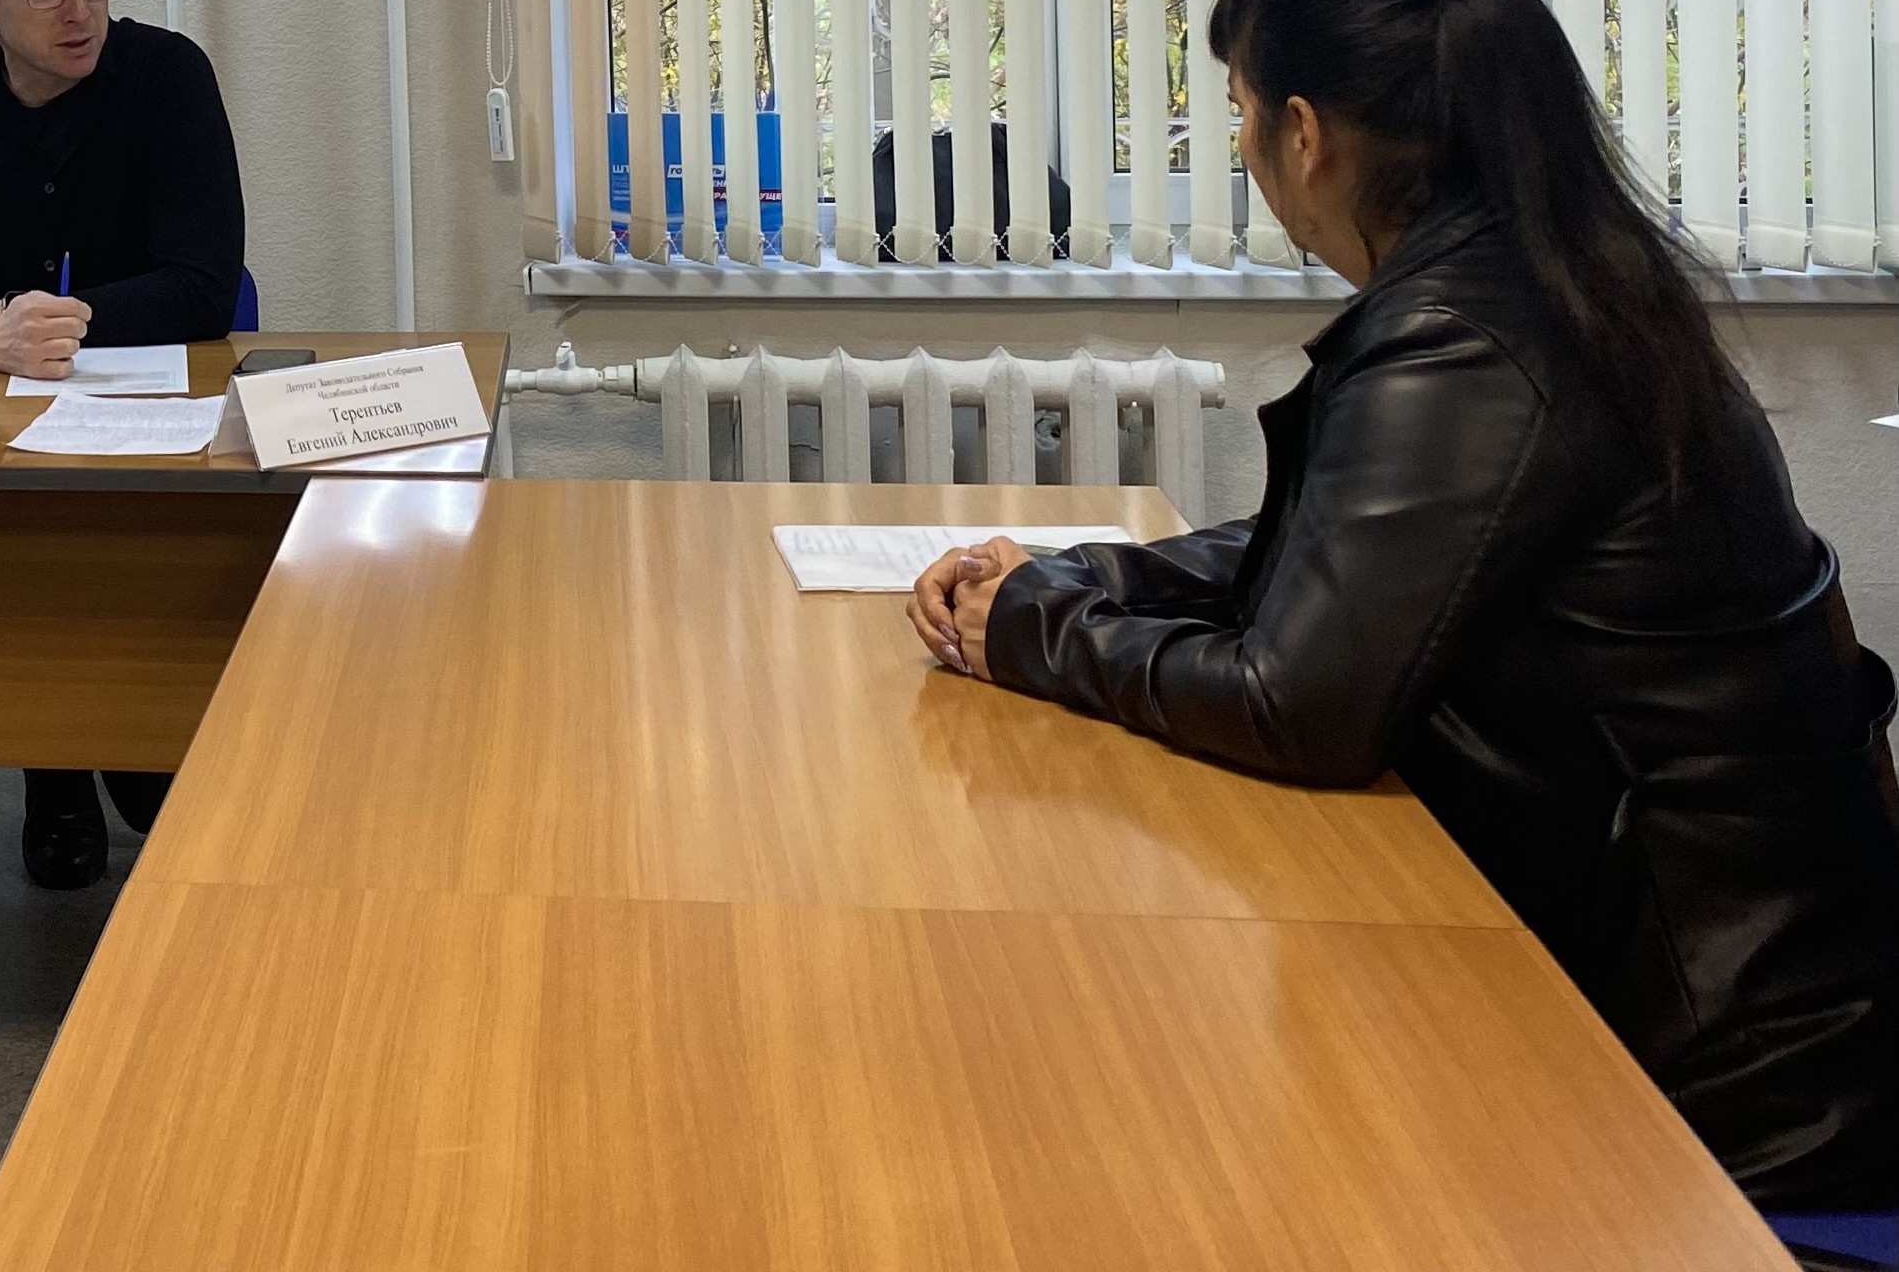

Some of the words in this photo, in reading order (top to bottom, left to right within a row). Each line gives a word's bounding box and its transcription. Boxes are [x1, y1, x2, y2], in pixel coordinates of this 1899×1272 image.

[329, 400, 403, 425] Терентьев
[287, 431, 347, 455] Евгений
[351, 415, 458, 445] Александрович
